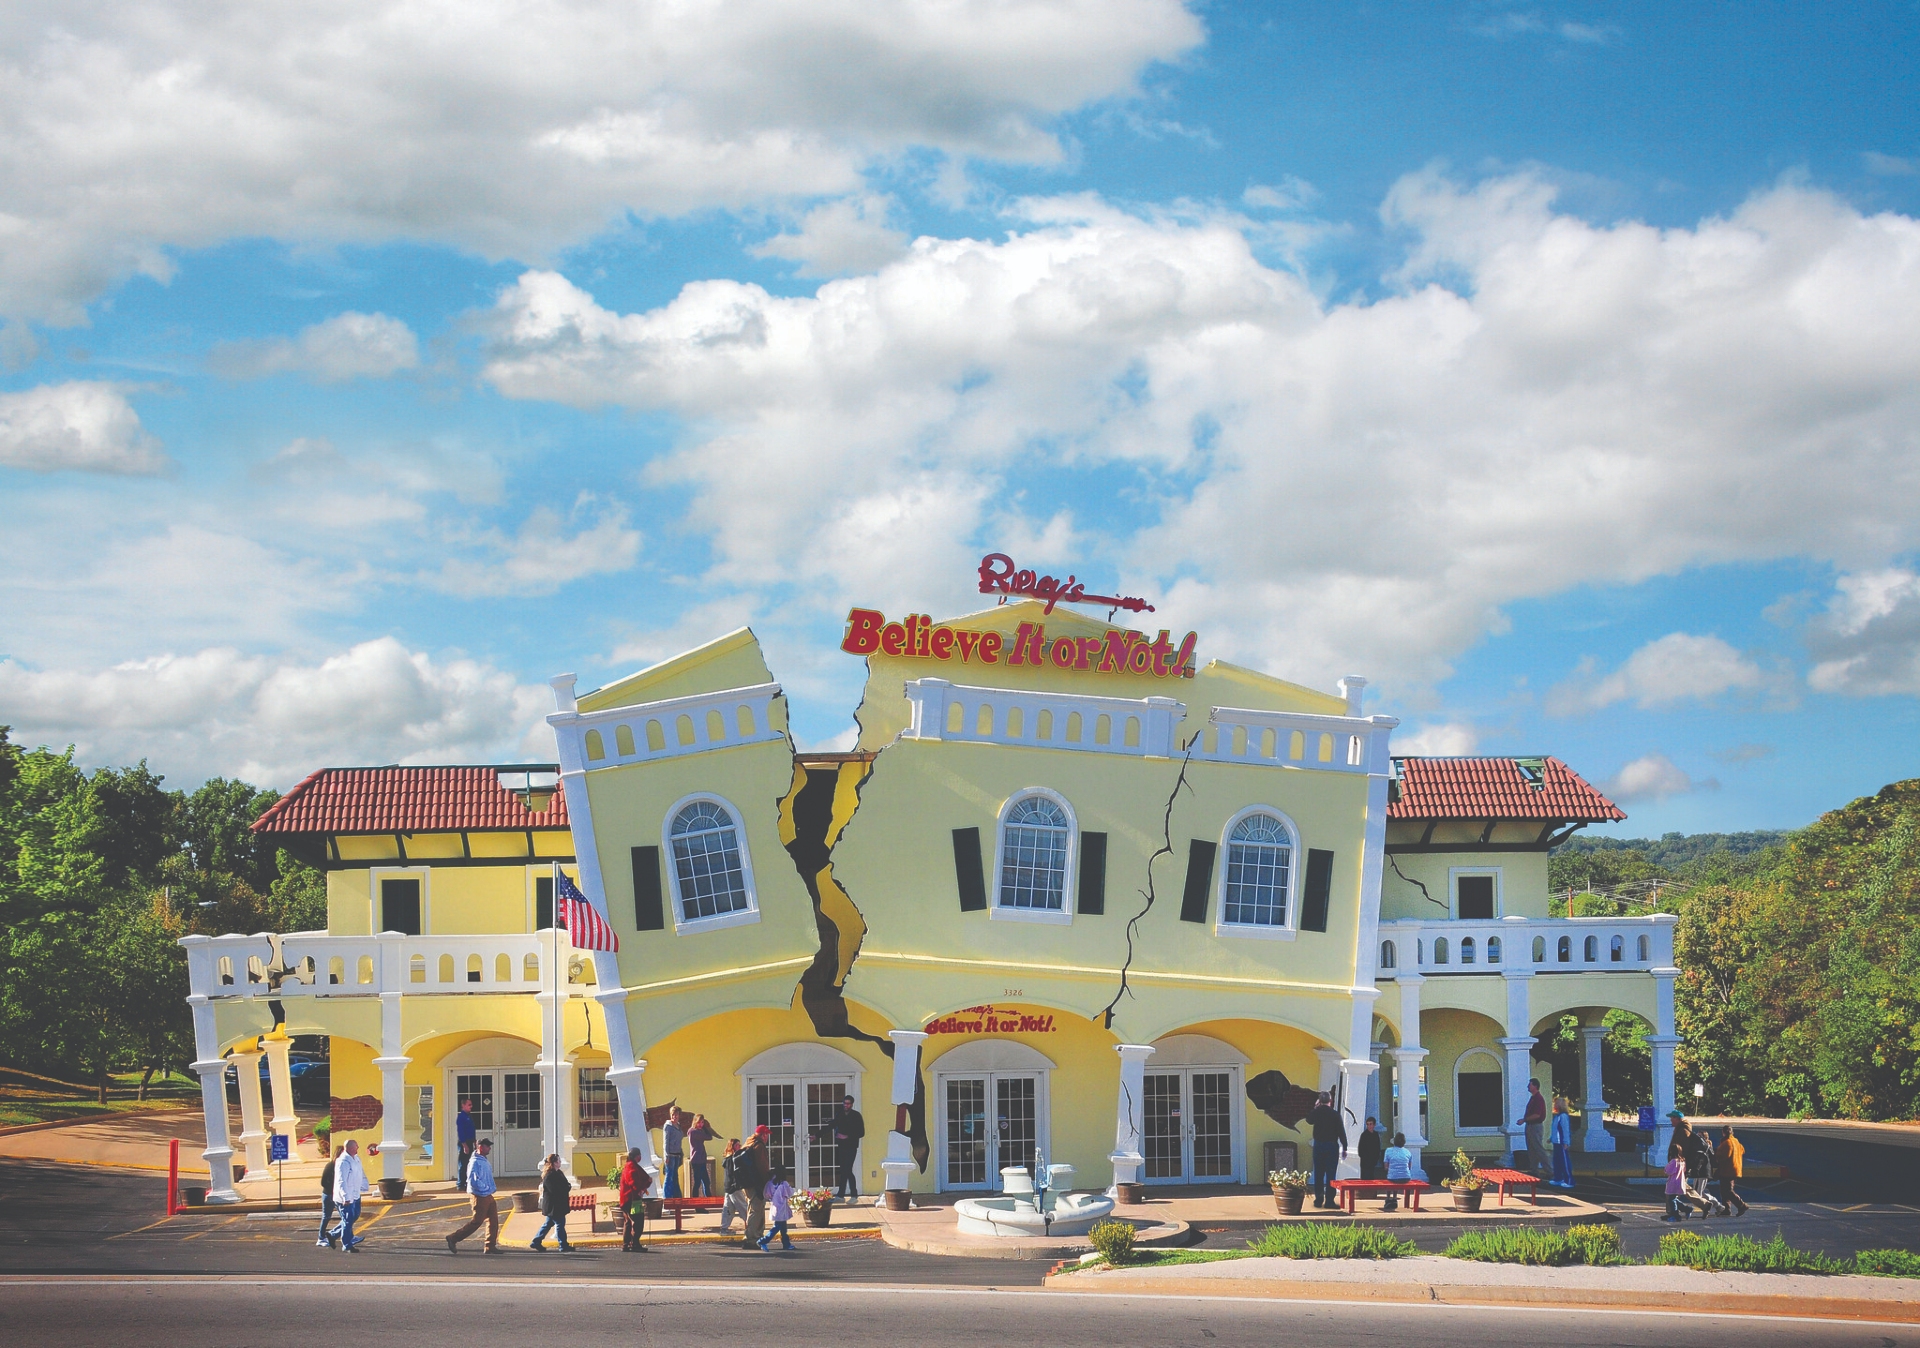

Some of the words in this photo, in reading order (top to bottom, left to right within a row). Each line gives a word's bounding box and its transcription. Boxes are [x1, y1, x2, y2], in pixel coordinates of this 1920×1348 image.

[978, 553, 1085, 615] Ripley's
[842, 608, 1003, 664] Believe
[1006, 621, 1046, 666] It
[1050, 636, 1102, 671] or
[1096, 630, 1197, 677] Not!
[1004, 989, 1023, 997] 3326
[925, 1017, 983, 1034] Believe
[984, 1016, 999, 1032] It
[1000, 1020, 1019, 1032] or
